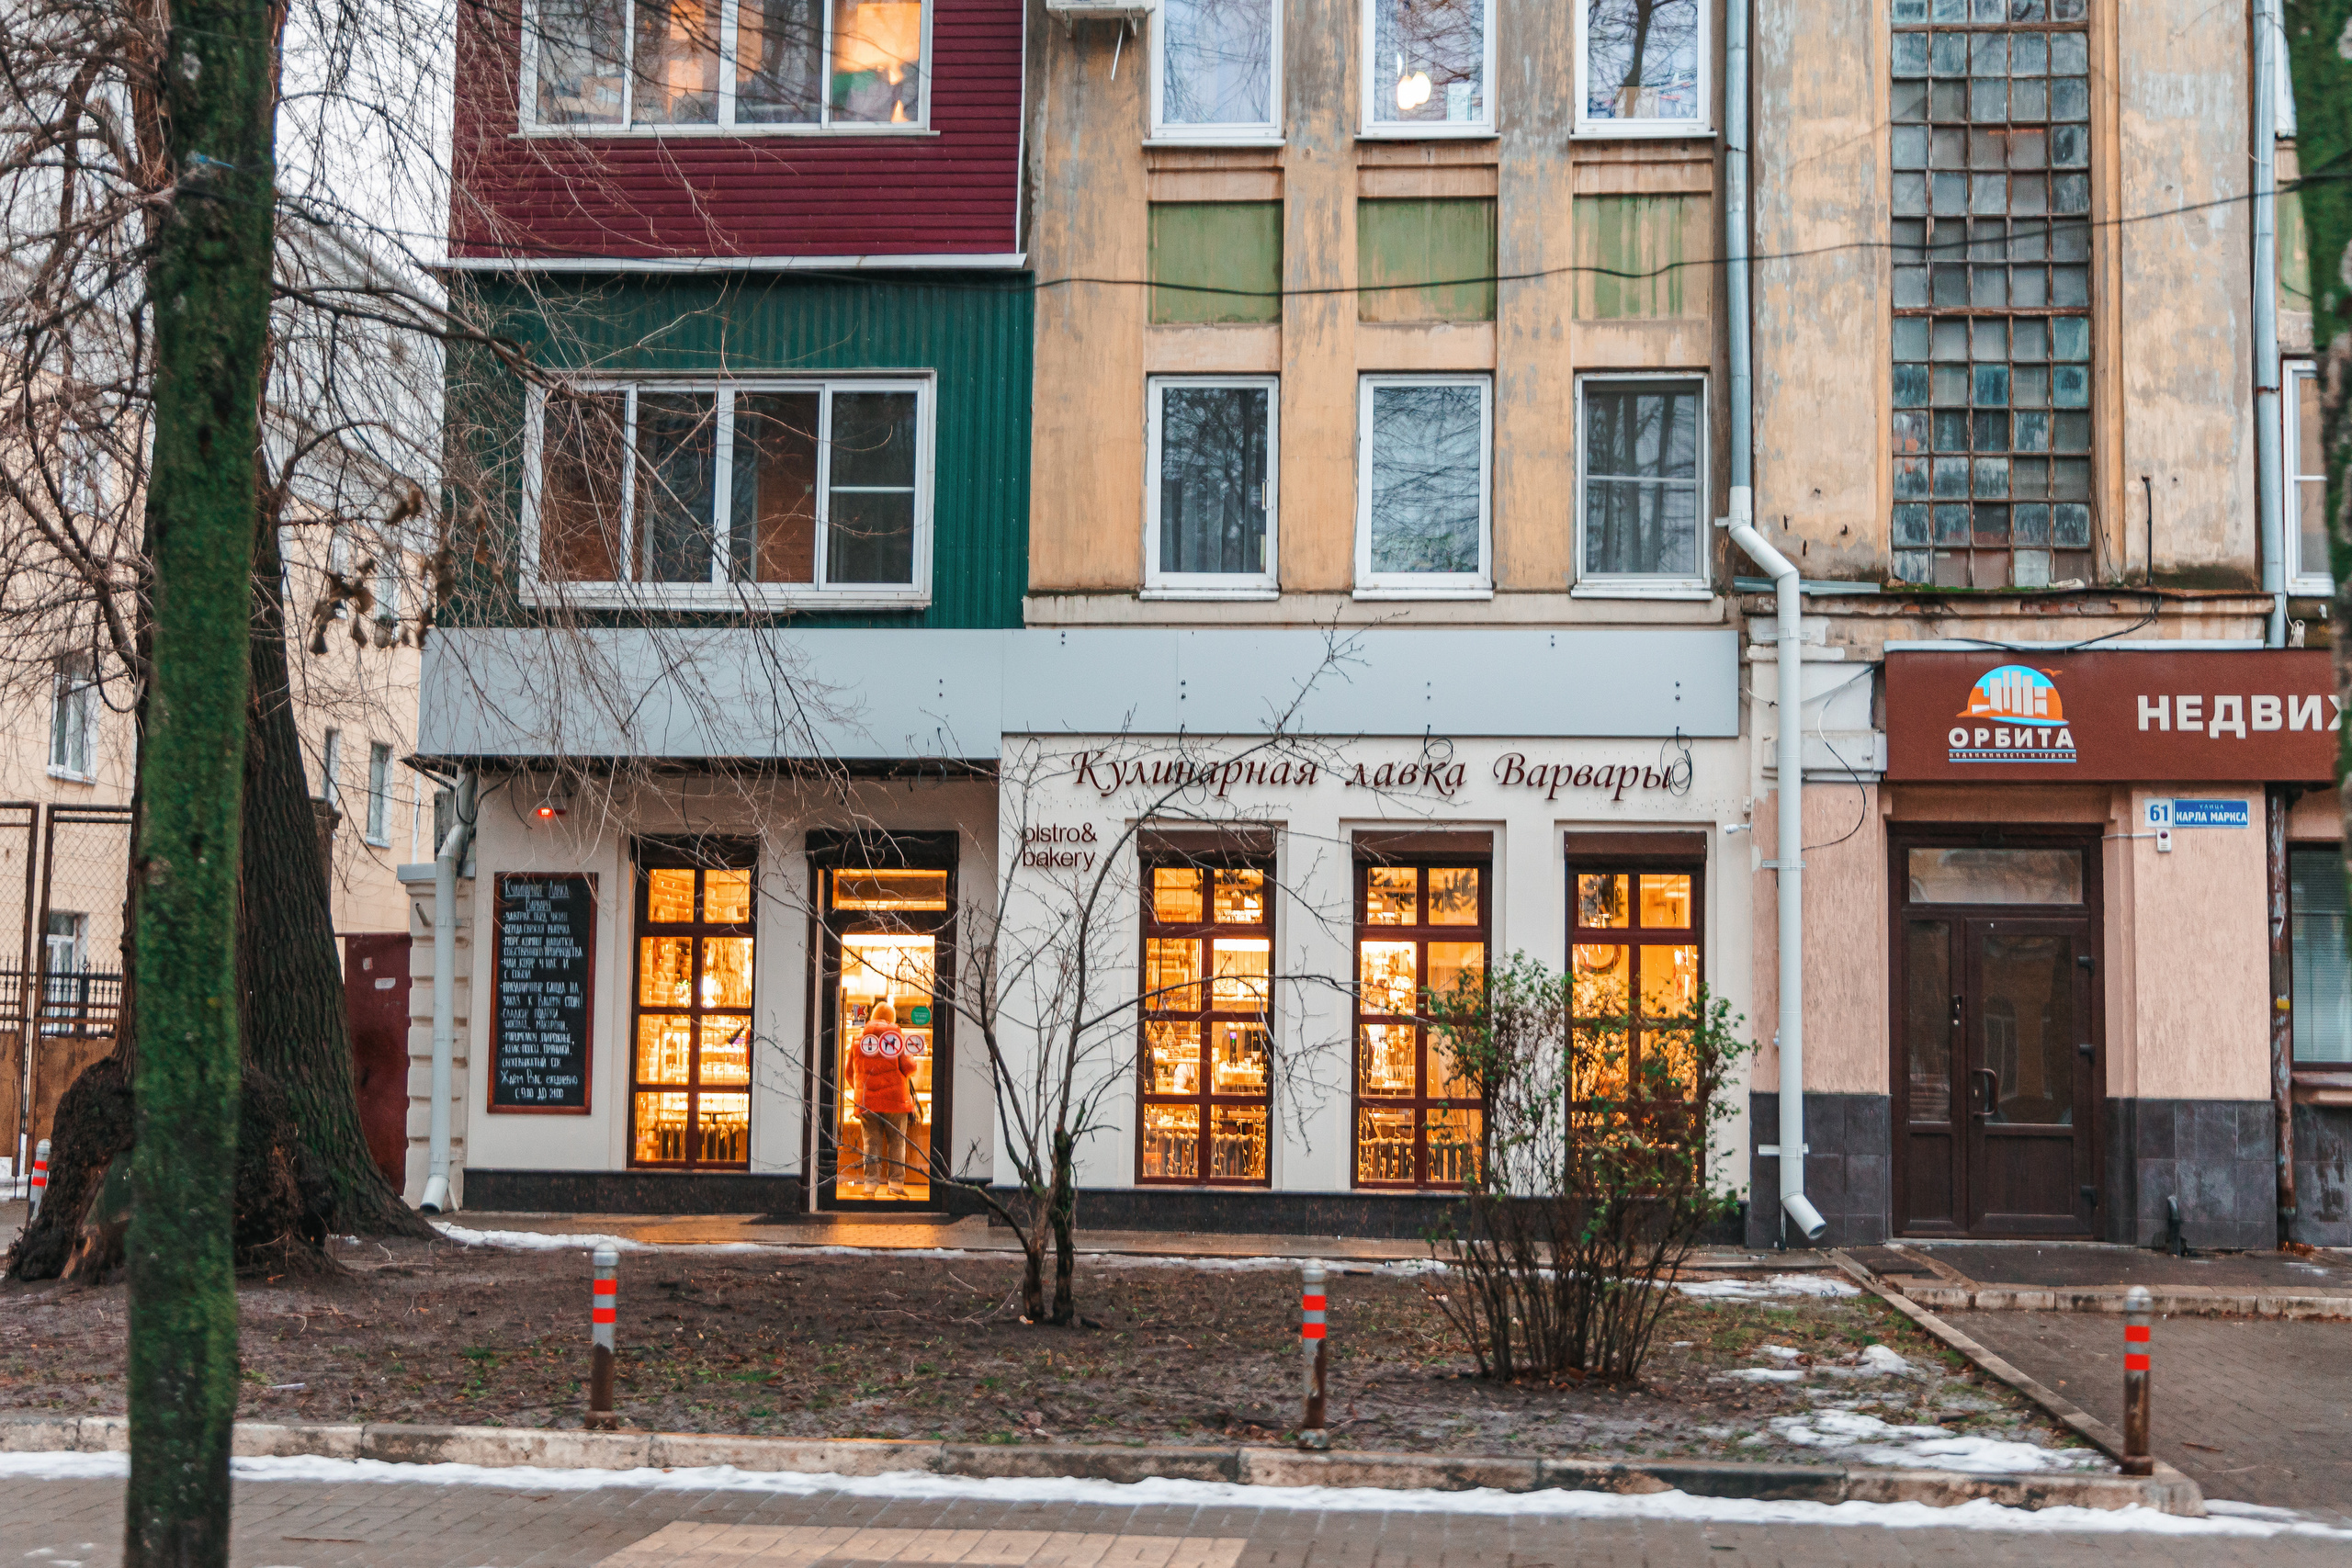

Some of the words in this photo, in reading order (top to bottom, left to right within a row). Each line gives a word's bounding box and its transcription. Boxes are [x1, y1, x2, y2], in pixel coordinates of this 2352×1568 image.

[1948, 727, 2075, 749] ОРБИТА
[1070, 750, 1318, 797] Кулинарная
[1345, 760, 1467, 796] лавка
[1493, 751, 1673, 801] Варвары
[2150, 804, 2168, 821] 61
[2176, 811, 2207, 823] КАРЛА
[2210, 812, 2247, 823] МАРКСА
[1023, 846, 1096, 873] bakery
